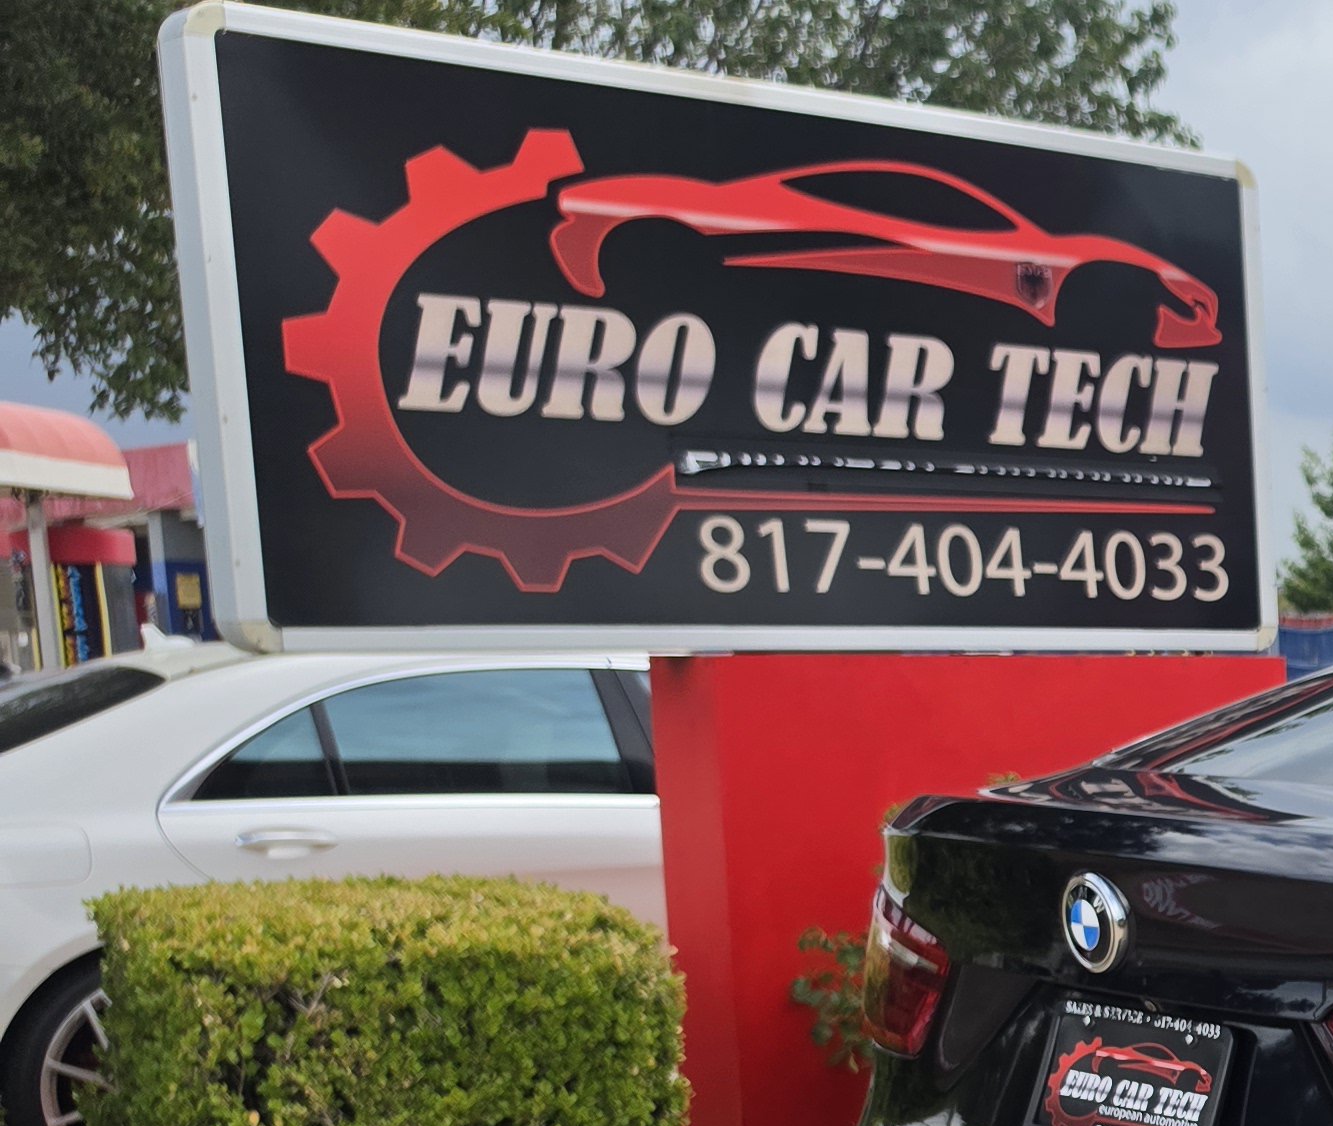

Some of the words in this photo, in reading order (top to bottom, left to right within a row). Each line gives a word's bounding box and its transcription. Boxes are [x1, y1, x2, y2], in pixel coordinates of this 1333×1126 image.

[398, 292, 716, 426] EURO
[754, 322, 955, 433] CAR
[988, 342, 1220, 458] TECH
[699, 514, 1230, 602] 817-404-4033
[1060, 1069, 1113, 1101] EURO
[1113, 1080, 1154, 1112] CAR
[1153, 1087, 1209, 1122] TECH
[1099, 1104, 1143, 1123] european
